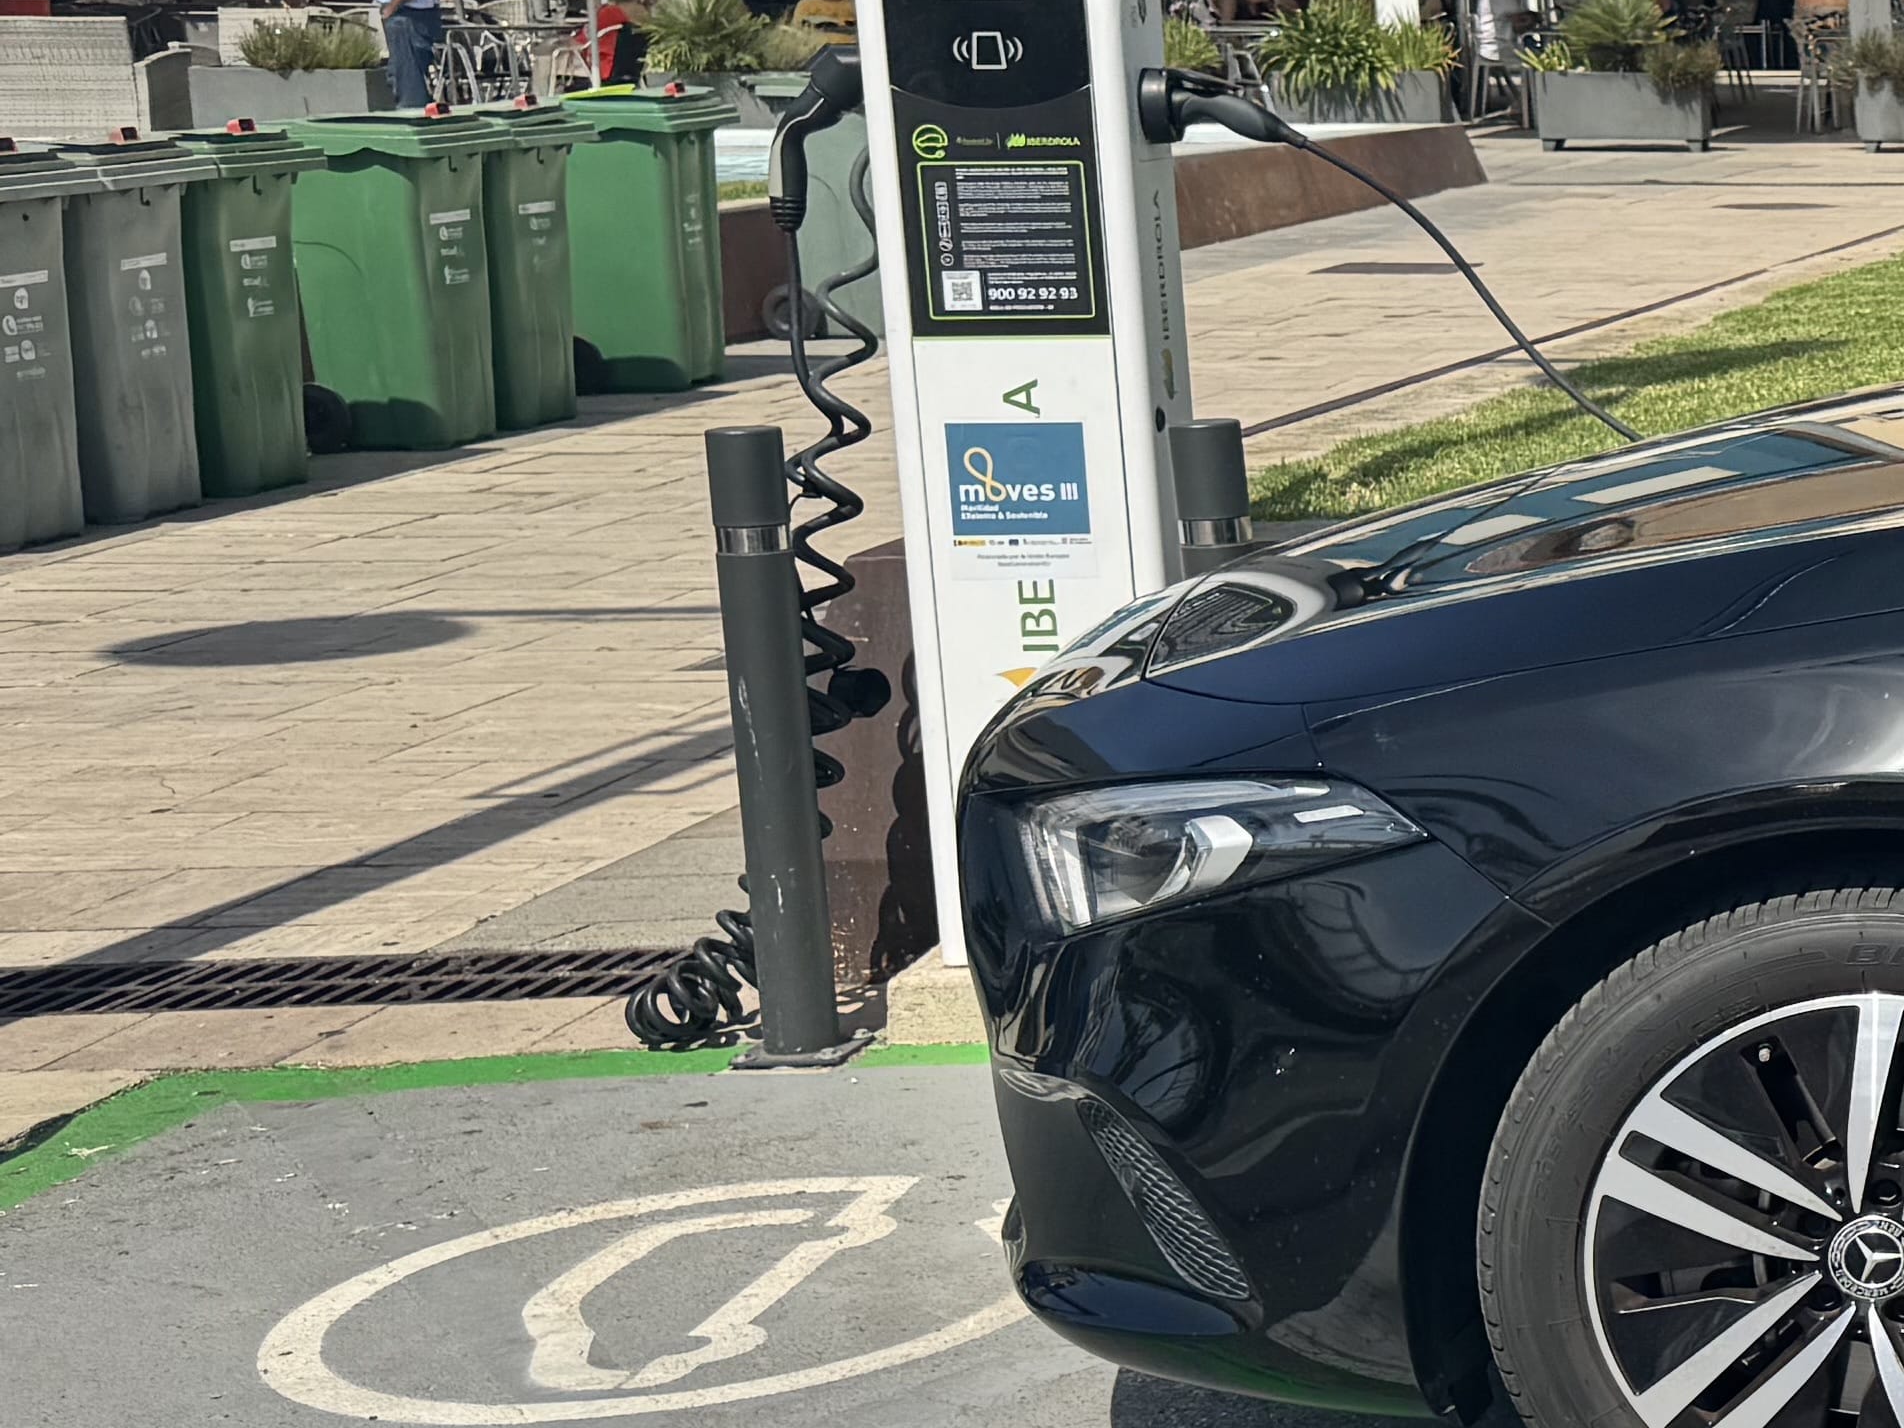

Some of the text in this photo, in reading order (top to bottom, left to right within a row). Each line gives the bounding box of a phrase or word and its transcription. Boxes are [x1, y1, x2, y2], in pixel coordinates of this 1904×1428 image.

[987, 287, 1016, 300] 900
[1017, 287, 1037, 300] 92
[1038, 287, 1057, 300] 92
